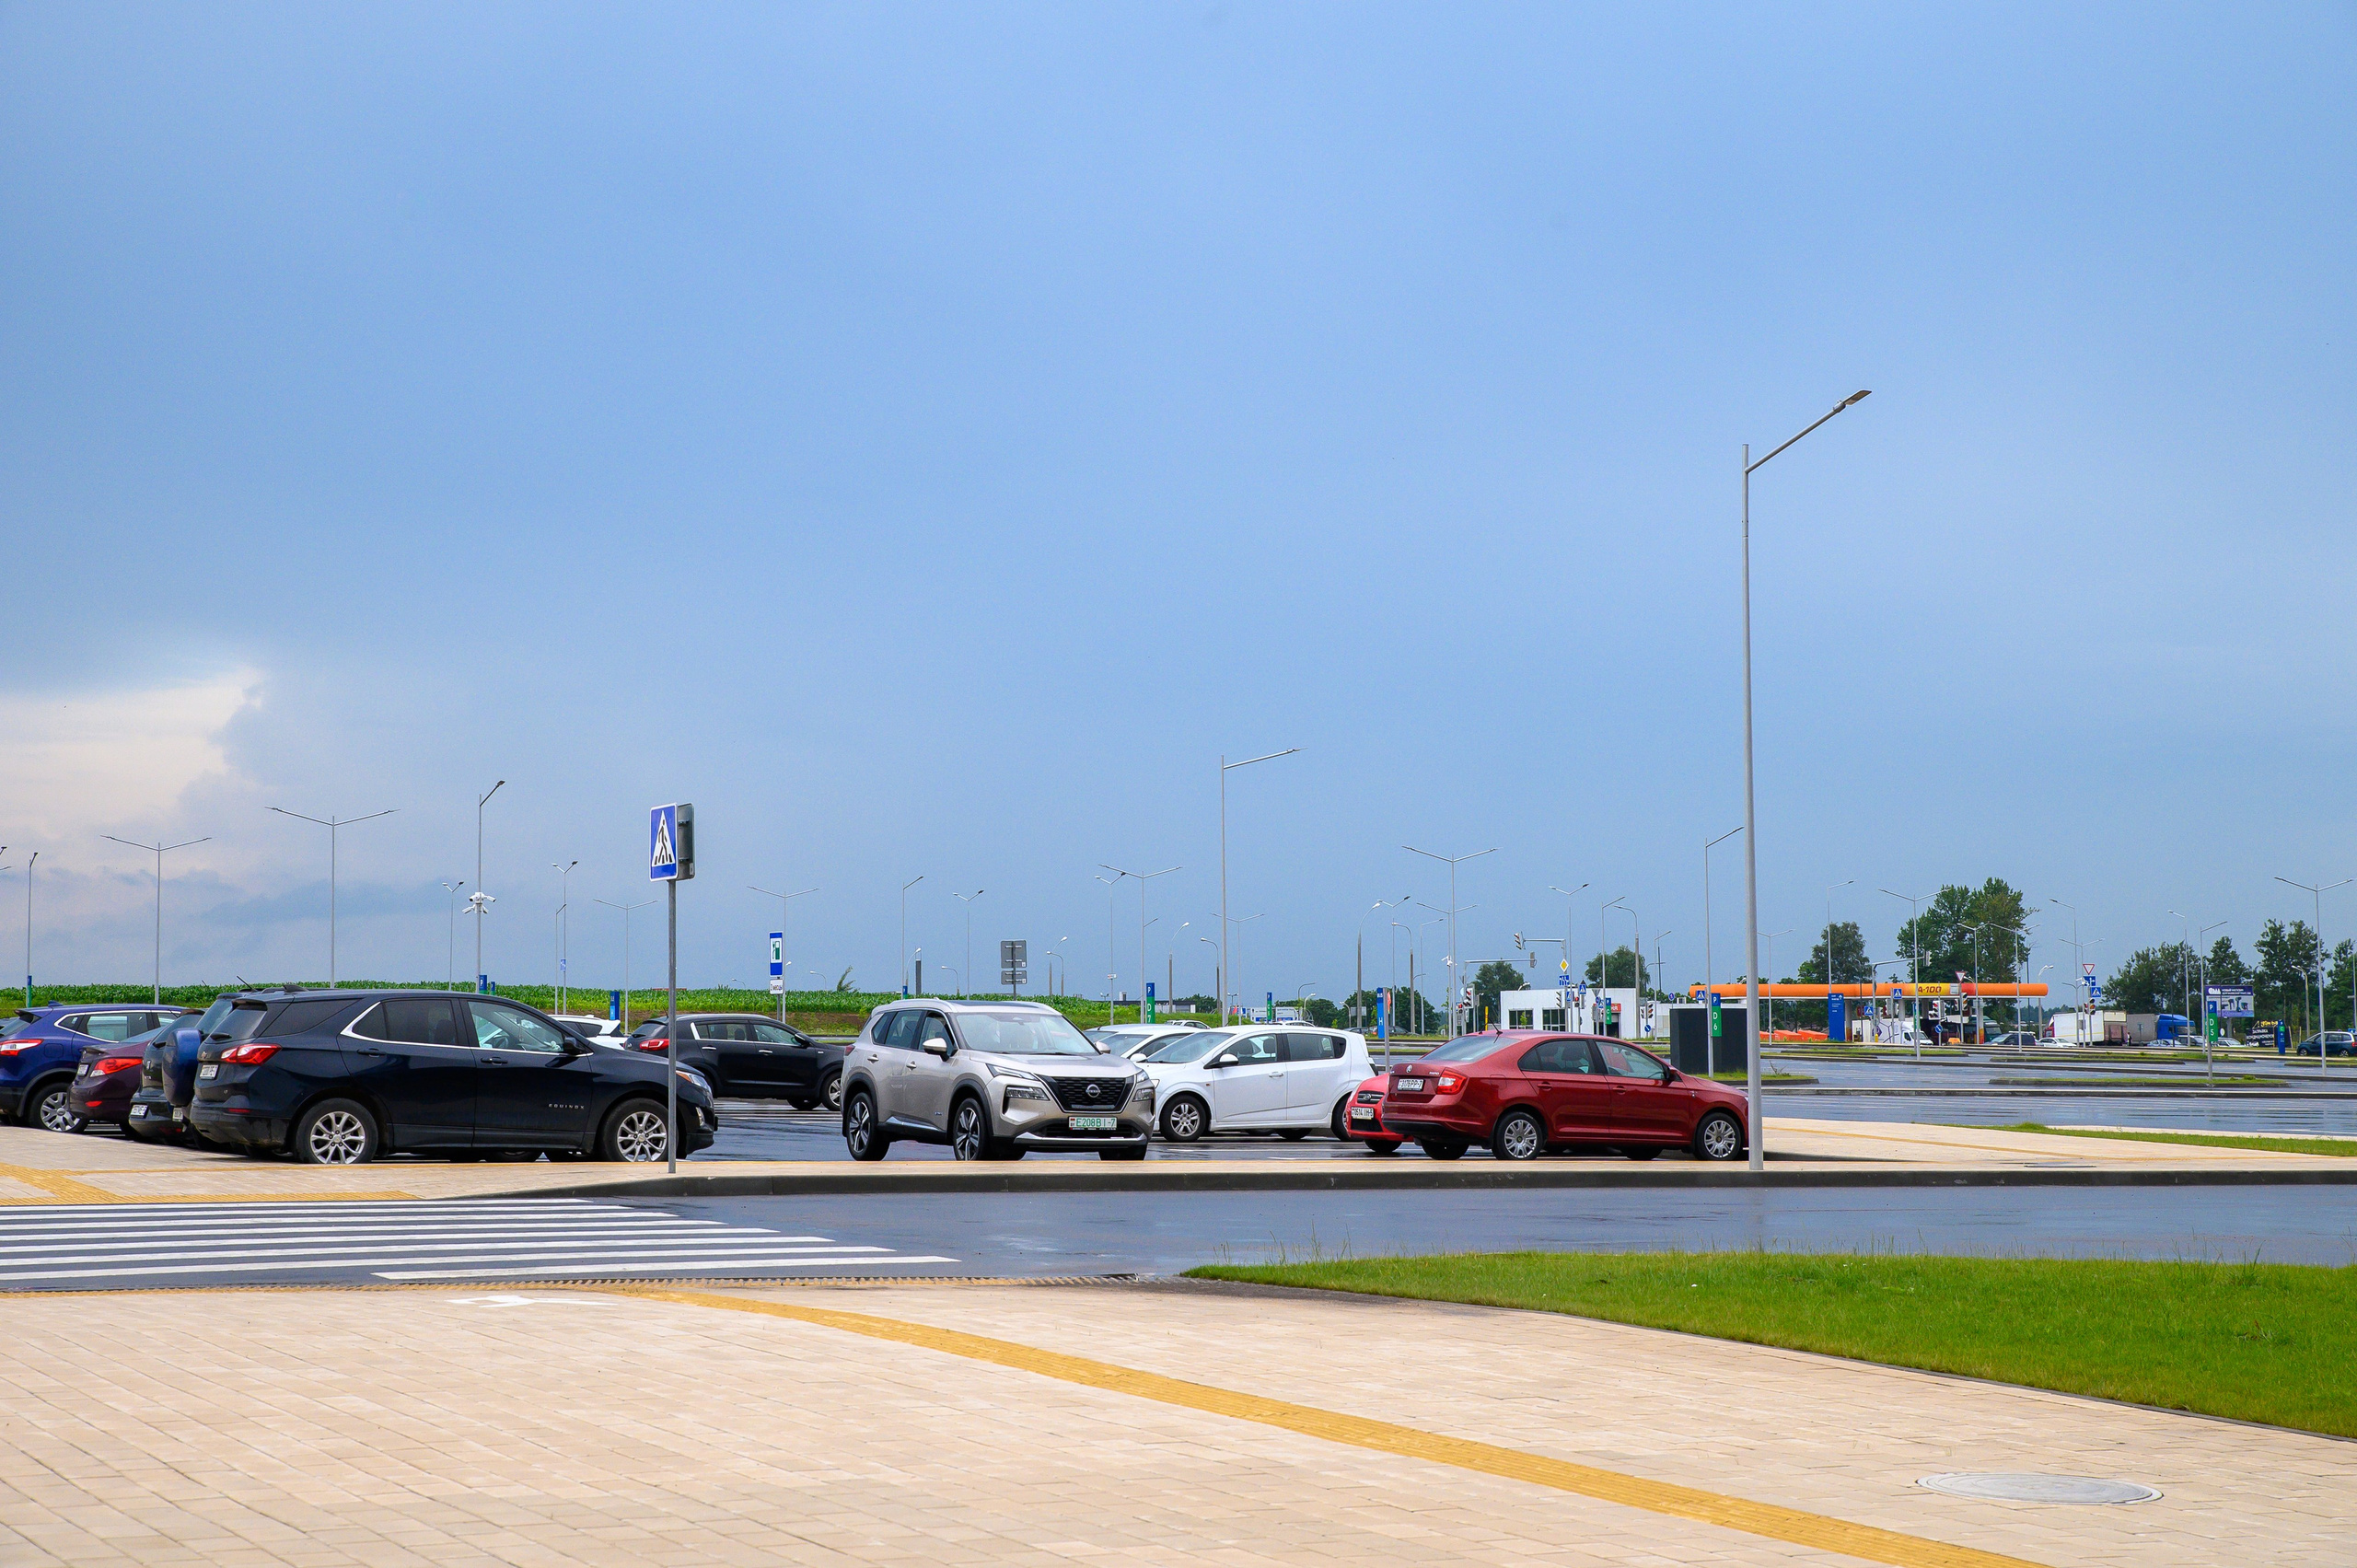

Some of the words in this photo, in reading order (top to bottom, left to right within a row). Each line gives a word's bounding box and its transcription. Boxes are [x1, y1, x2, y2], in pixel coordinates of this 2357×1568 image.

[1147, 1003, 1151, 1011] D
[1148, 1015, 1151, 1023] 7
[1379, 1017, 1383, 1026] H
[1076, 1118, 1115, 1127] E208BI-7
